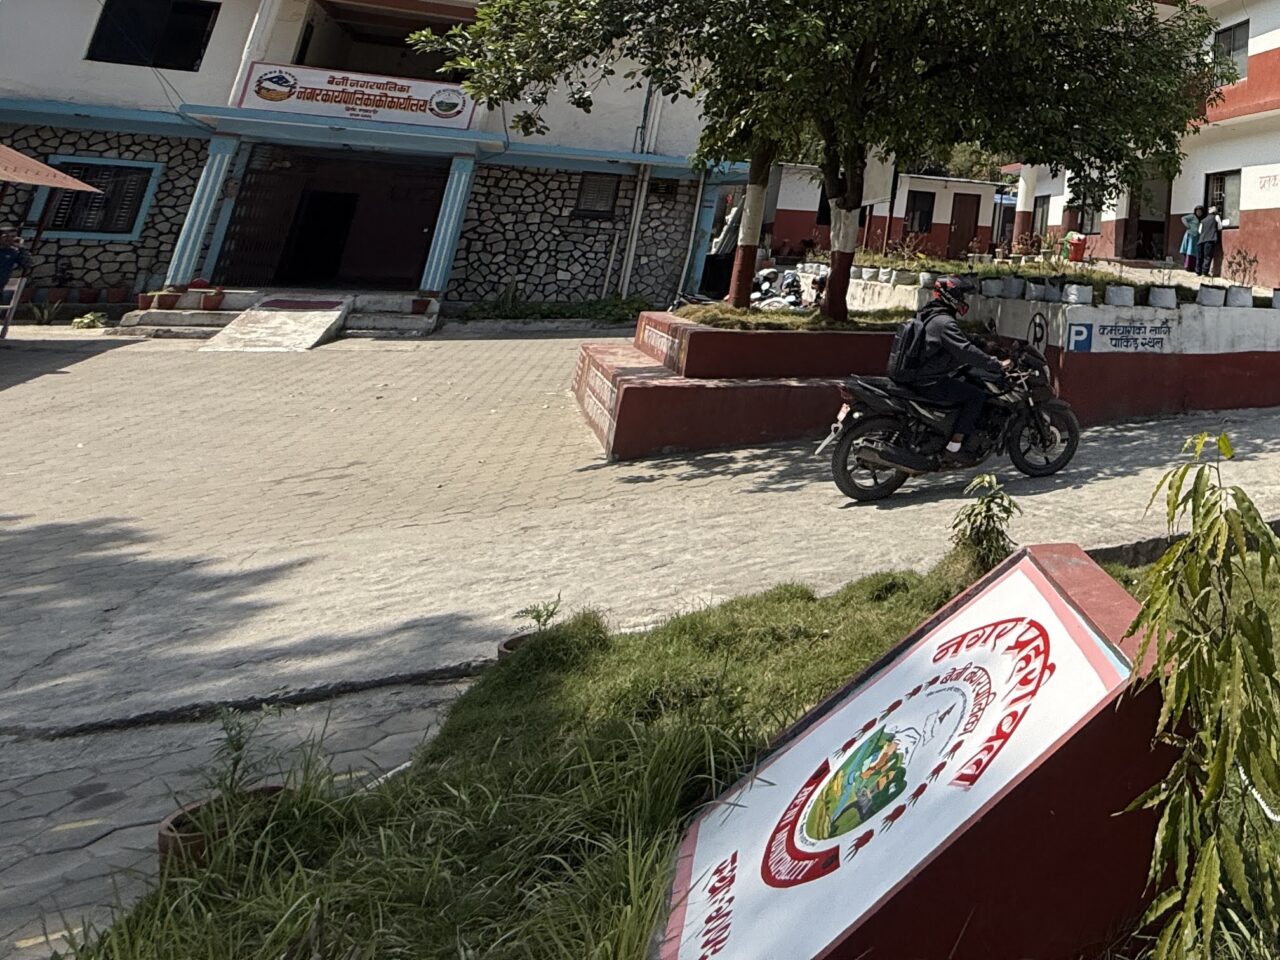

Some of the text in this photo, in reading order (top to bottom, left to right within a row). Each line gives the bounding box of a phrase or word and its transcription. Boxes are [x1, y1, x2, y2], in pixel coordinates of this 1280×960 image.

[349, 79, 411, 93] नगरपालिका
[933, 617, 1027, 664] नगर
[780, 782, 817, 828] BENI
[768, 825, 819, 880] MUNICIPALITY
